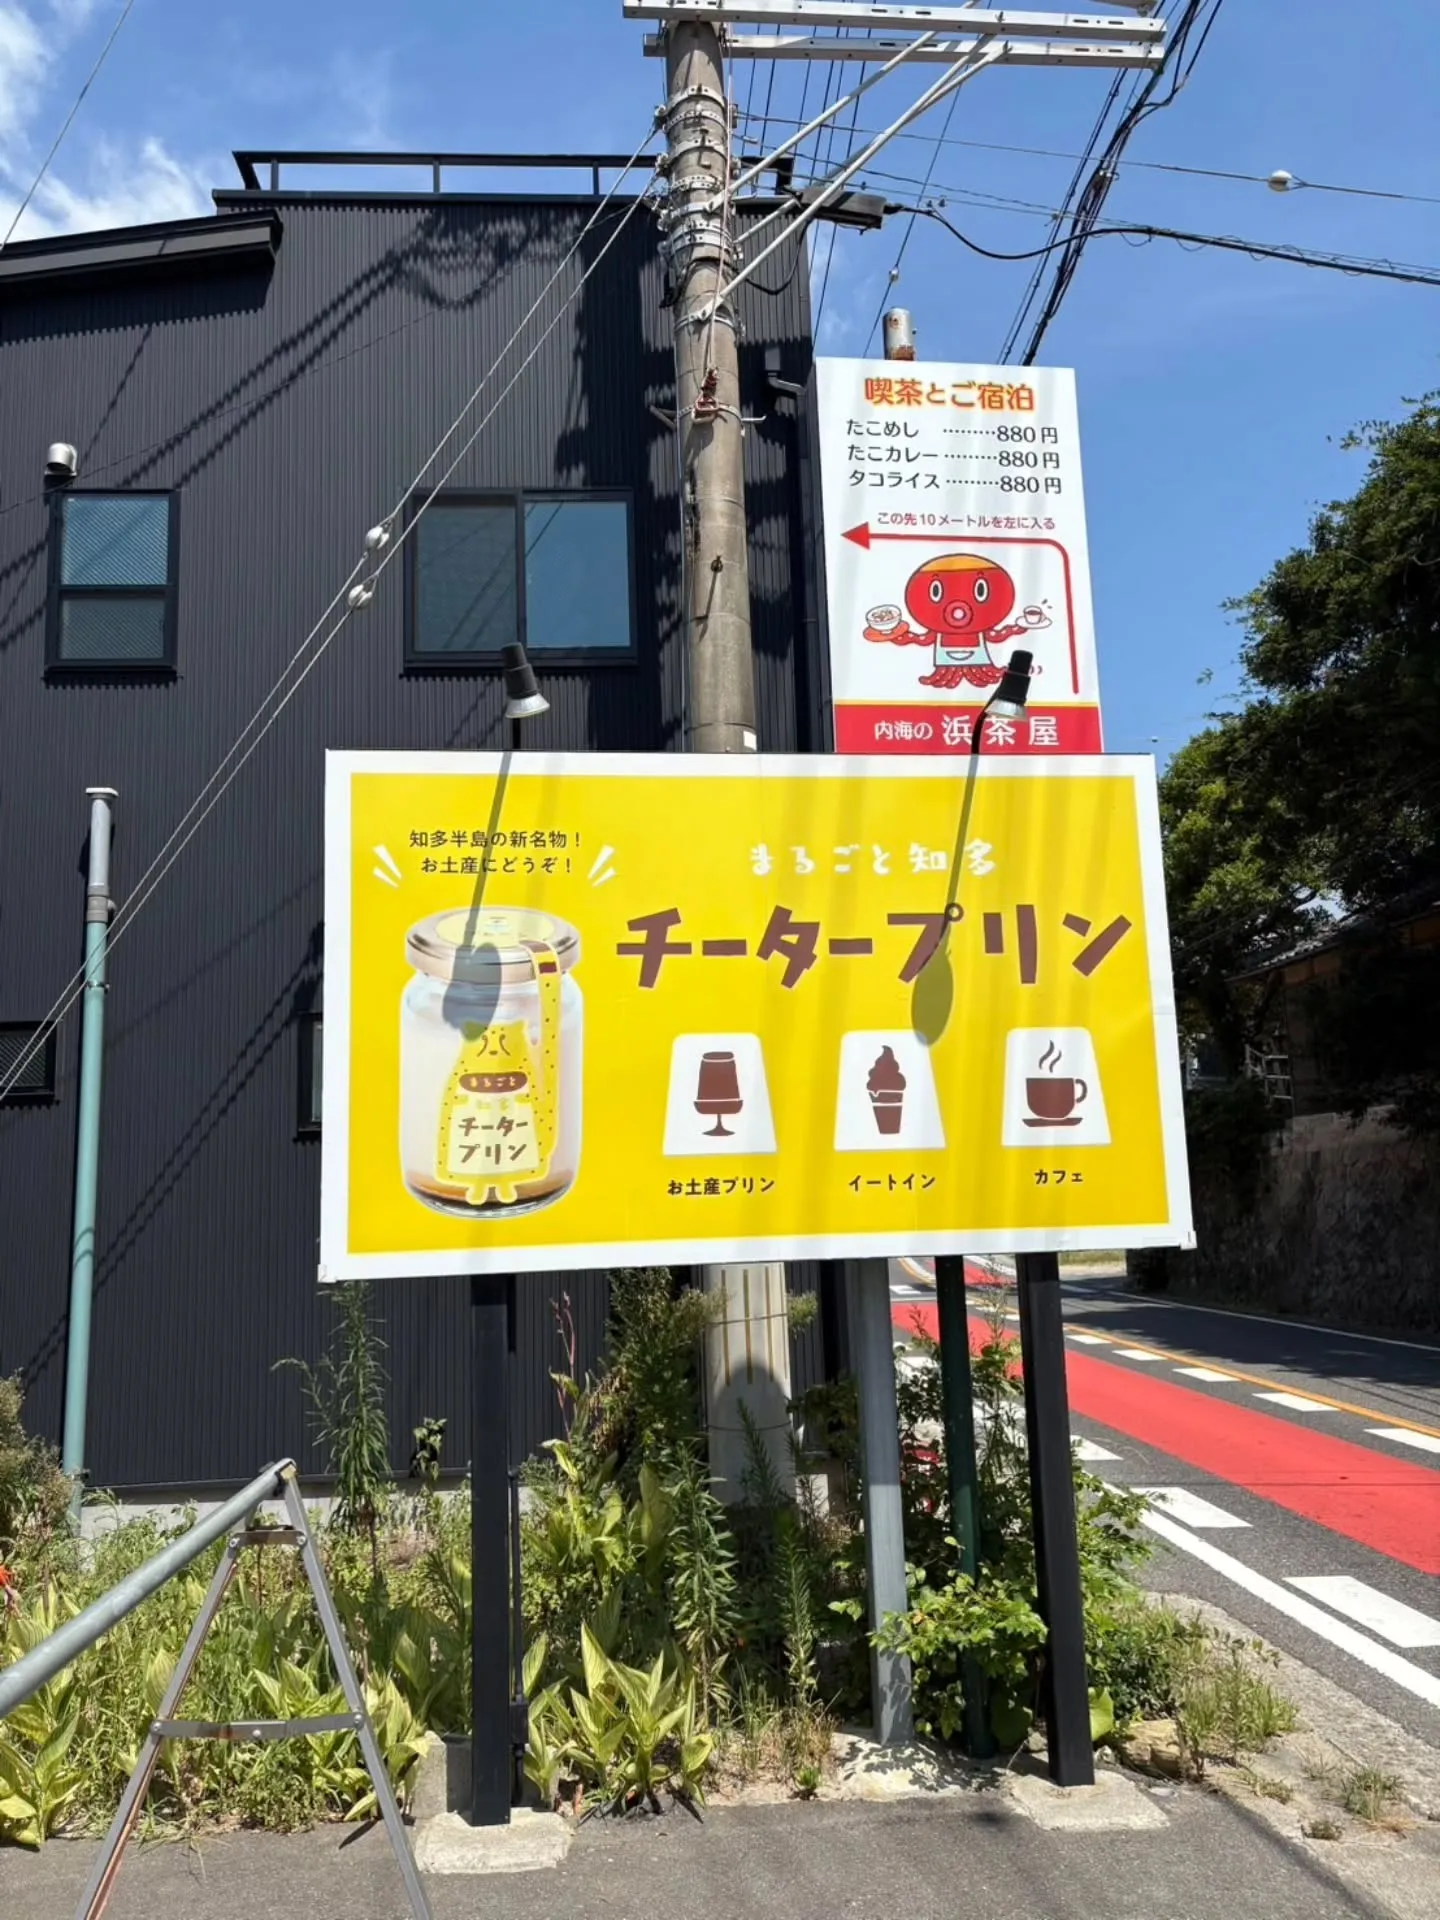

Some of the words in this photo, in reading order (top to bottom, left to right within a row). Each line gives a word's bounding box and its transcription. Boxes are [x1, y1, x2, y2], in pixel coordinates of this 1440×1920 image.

[864, 377, 1036, 411] 喫茶とご宿泊
[846, 419, 919, 438] たこめし
[847, 444, 938, 462] たこカレー
[848, 469, 940, 489] タコライス
[877, 512, 1055, 530] この先10メートルを左に入る
[874, 719, 933, 740] 内海の
[409, 829, 582, 849] 知多半島の新名物！
[421, 856, 572, 875] お土産にどうぞ！
[750, 839, 997, 876] まるごと知多
[616, 903, 1132, 989] チータープリン
[458, 1115, 528, 1137] チーター
[458, 1143, 527, 1165] プリン
[667, 1176, 775, 1196] お土産プリン
[848, 1172, 936, 1191] イートイン
[1034, 1168, 1084, 1186] カフェ
